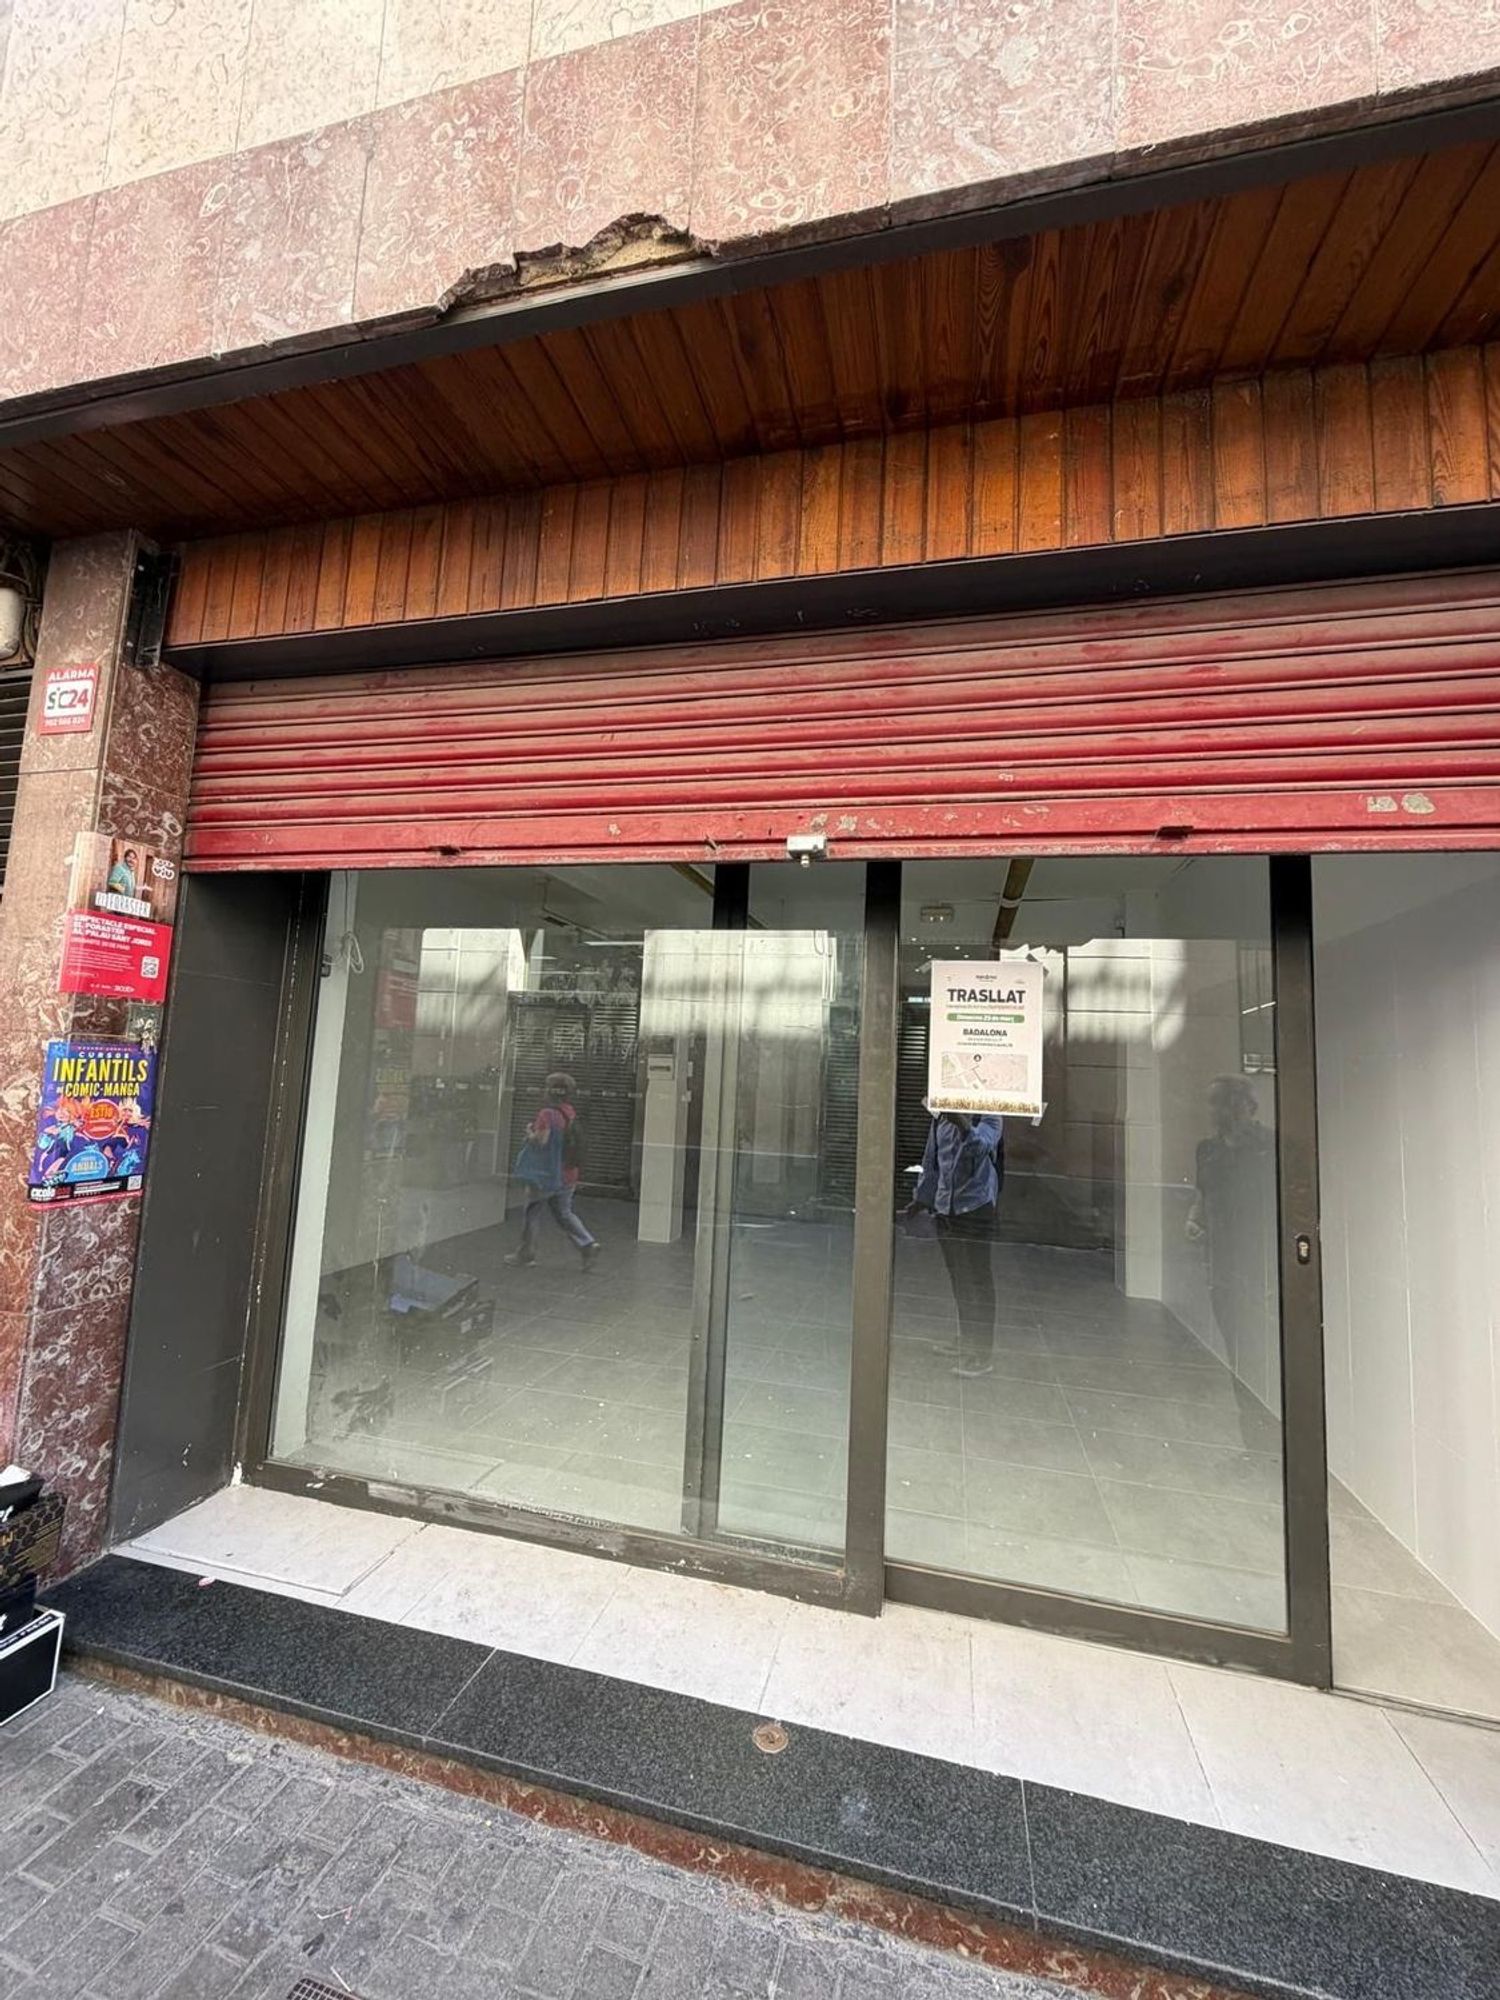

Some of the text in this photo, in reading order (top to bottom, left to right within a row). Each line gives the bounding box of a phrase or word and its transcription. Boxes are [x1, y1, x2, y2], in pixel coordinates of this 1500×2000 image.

[48, 669, 95, 681] ALARMA
[947, 989, 1026, 1004] TRASLLAT
[963, 1028, 1008, 1037] BADALONA
[53, 1058, 149, 1082] INFANTILS
